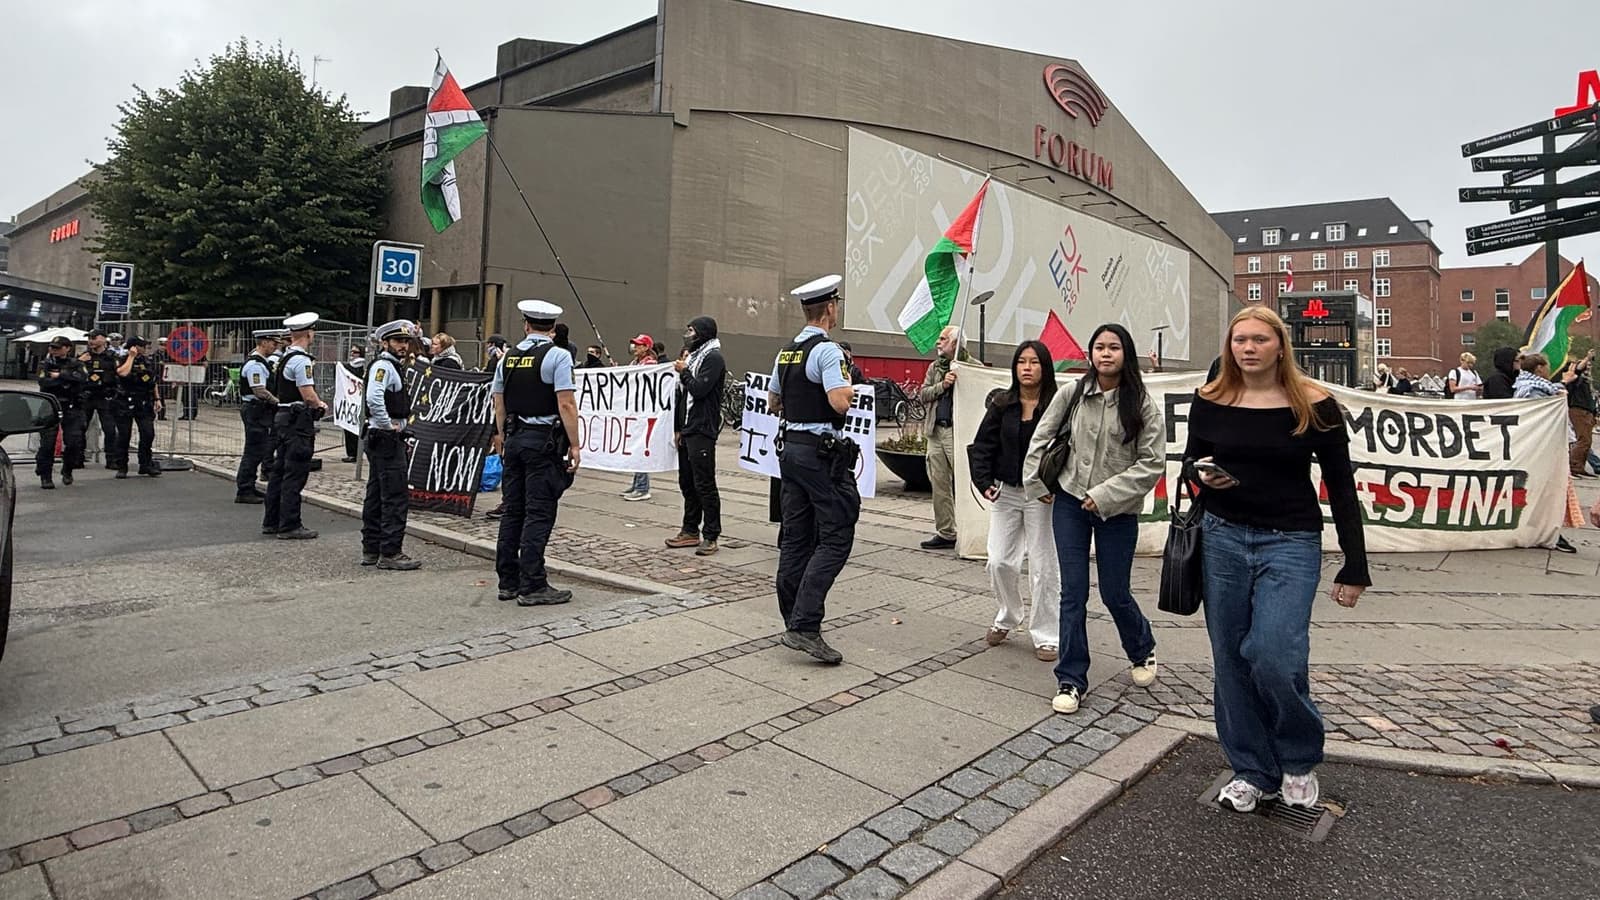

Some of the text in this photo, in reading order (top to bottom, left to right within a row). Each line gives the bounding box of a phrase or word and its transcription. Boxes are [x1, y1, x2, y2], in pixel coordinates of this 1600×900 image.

[1035, 125, 1113, 191] FORUM
[50, 219, 79, 244] FORUM
[110, 268, 127, 285] P
[385, 257, 413, 277] 30
[385, 284, 410, 293] Zone
[578, 372, 675, 412] ARMING
[426, 442, 482, 492] NOW
